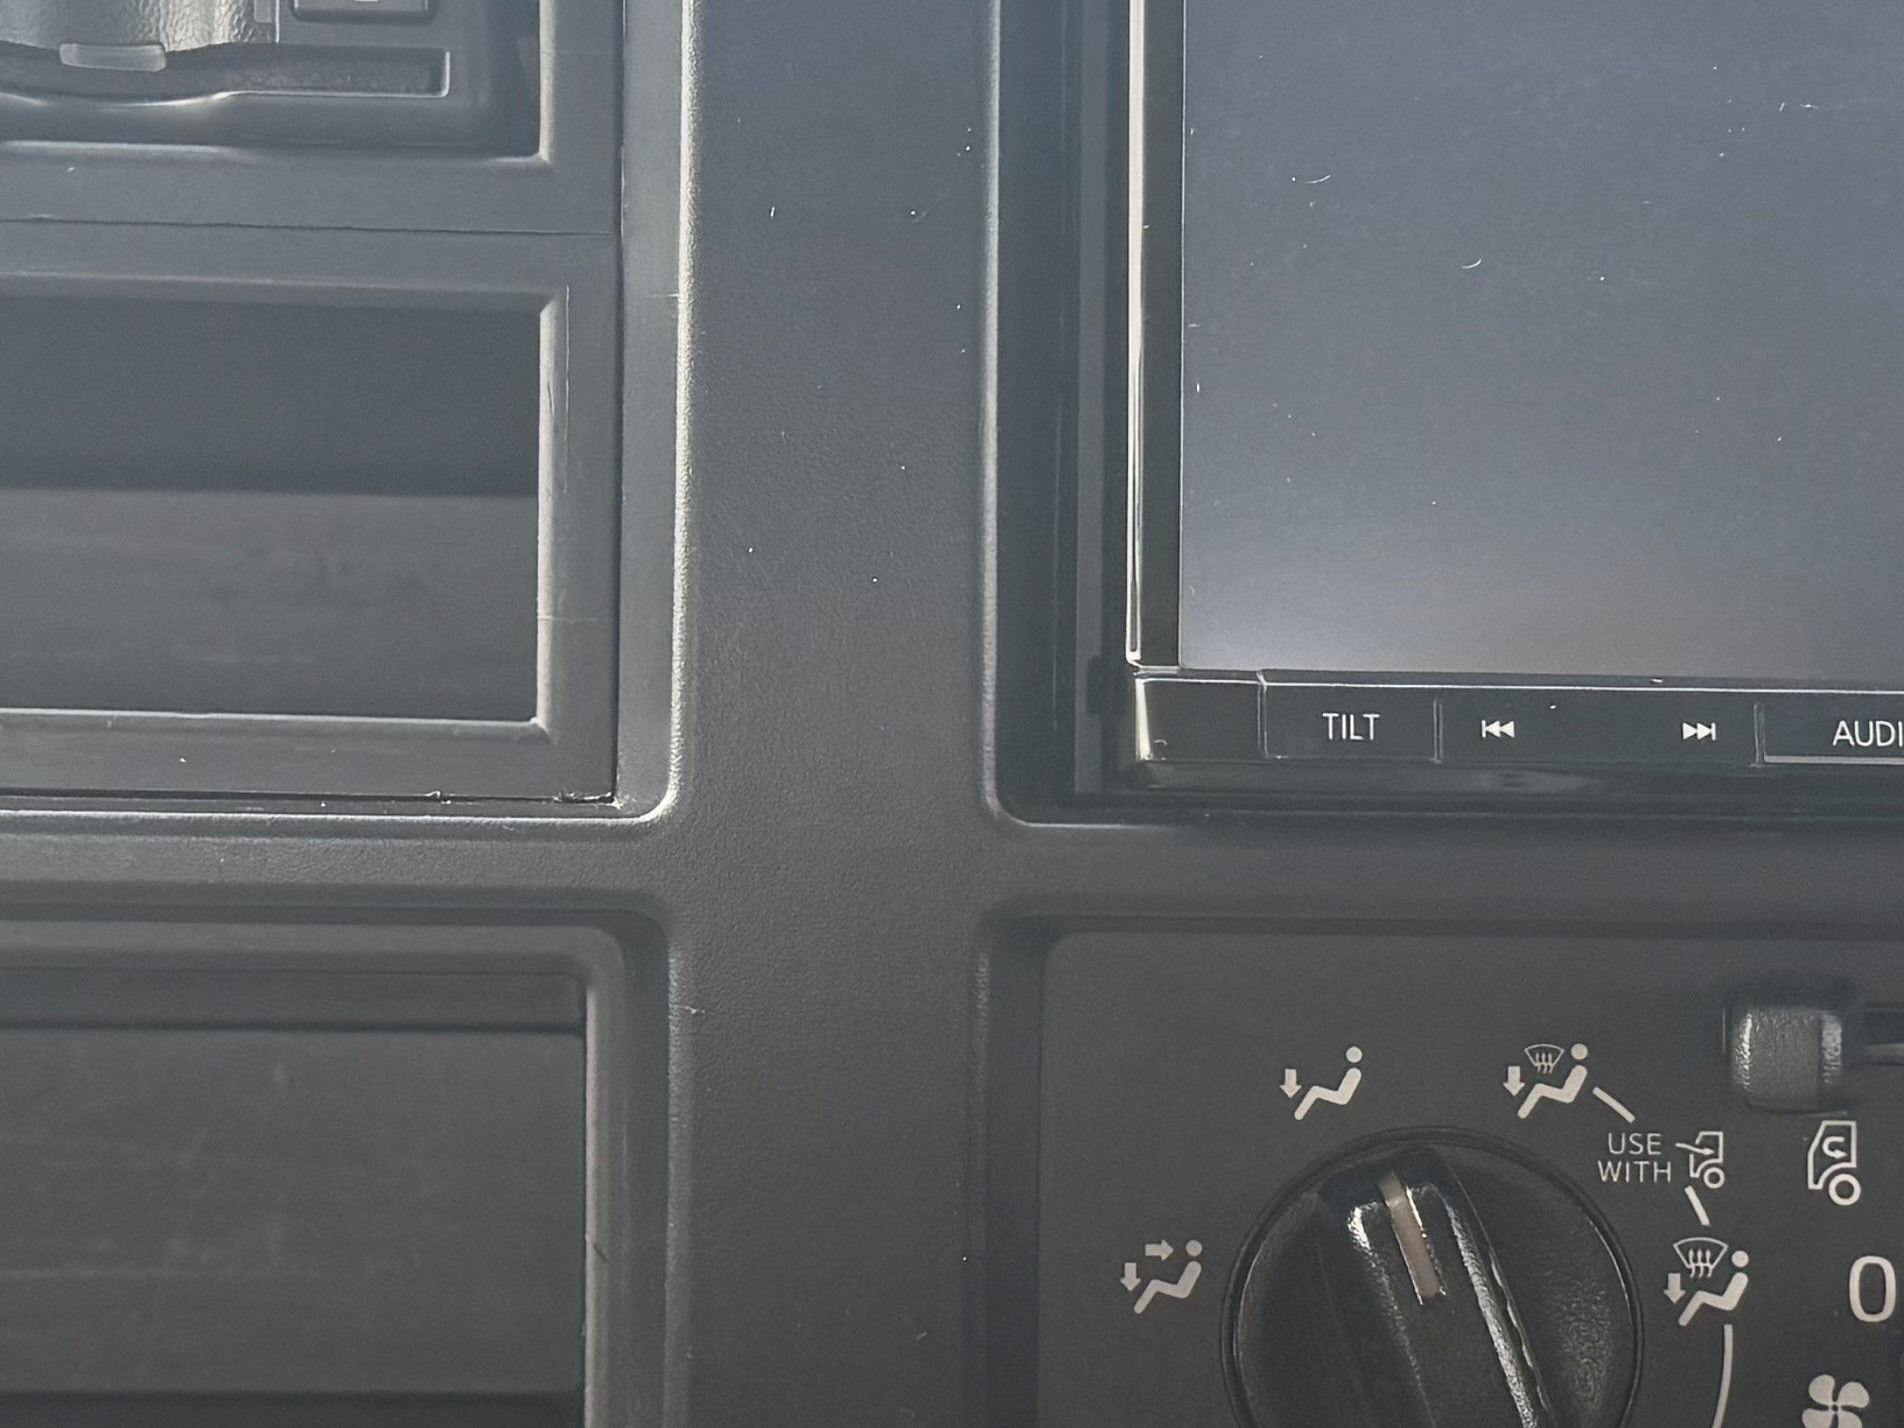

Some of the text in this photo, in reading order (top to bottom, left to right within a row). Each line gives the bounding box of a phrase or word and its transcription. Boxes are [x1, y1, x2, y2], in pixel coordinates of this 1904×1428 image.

[1323, 713, 1379, 740] TILT
[1609, 1133, 1661, 1155] USE
[1598, 1161, 1671, 1182] WITH
[1850, 1256, 1896, 1322] 0
